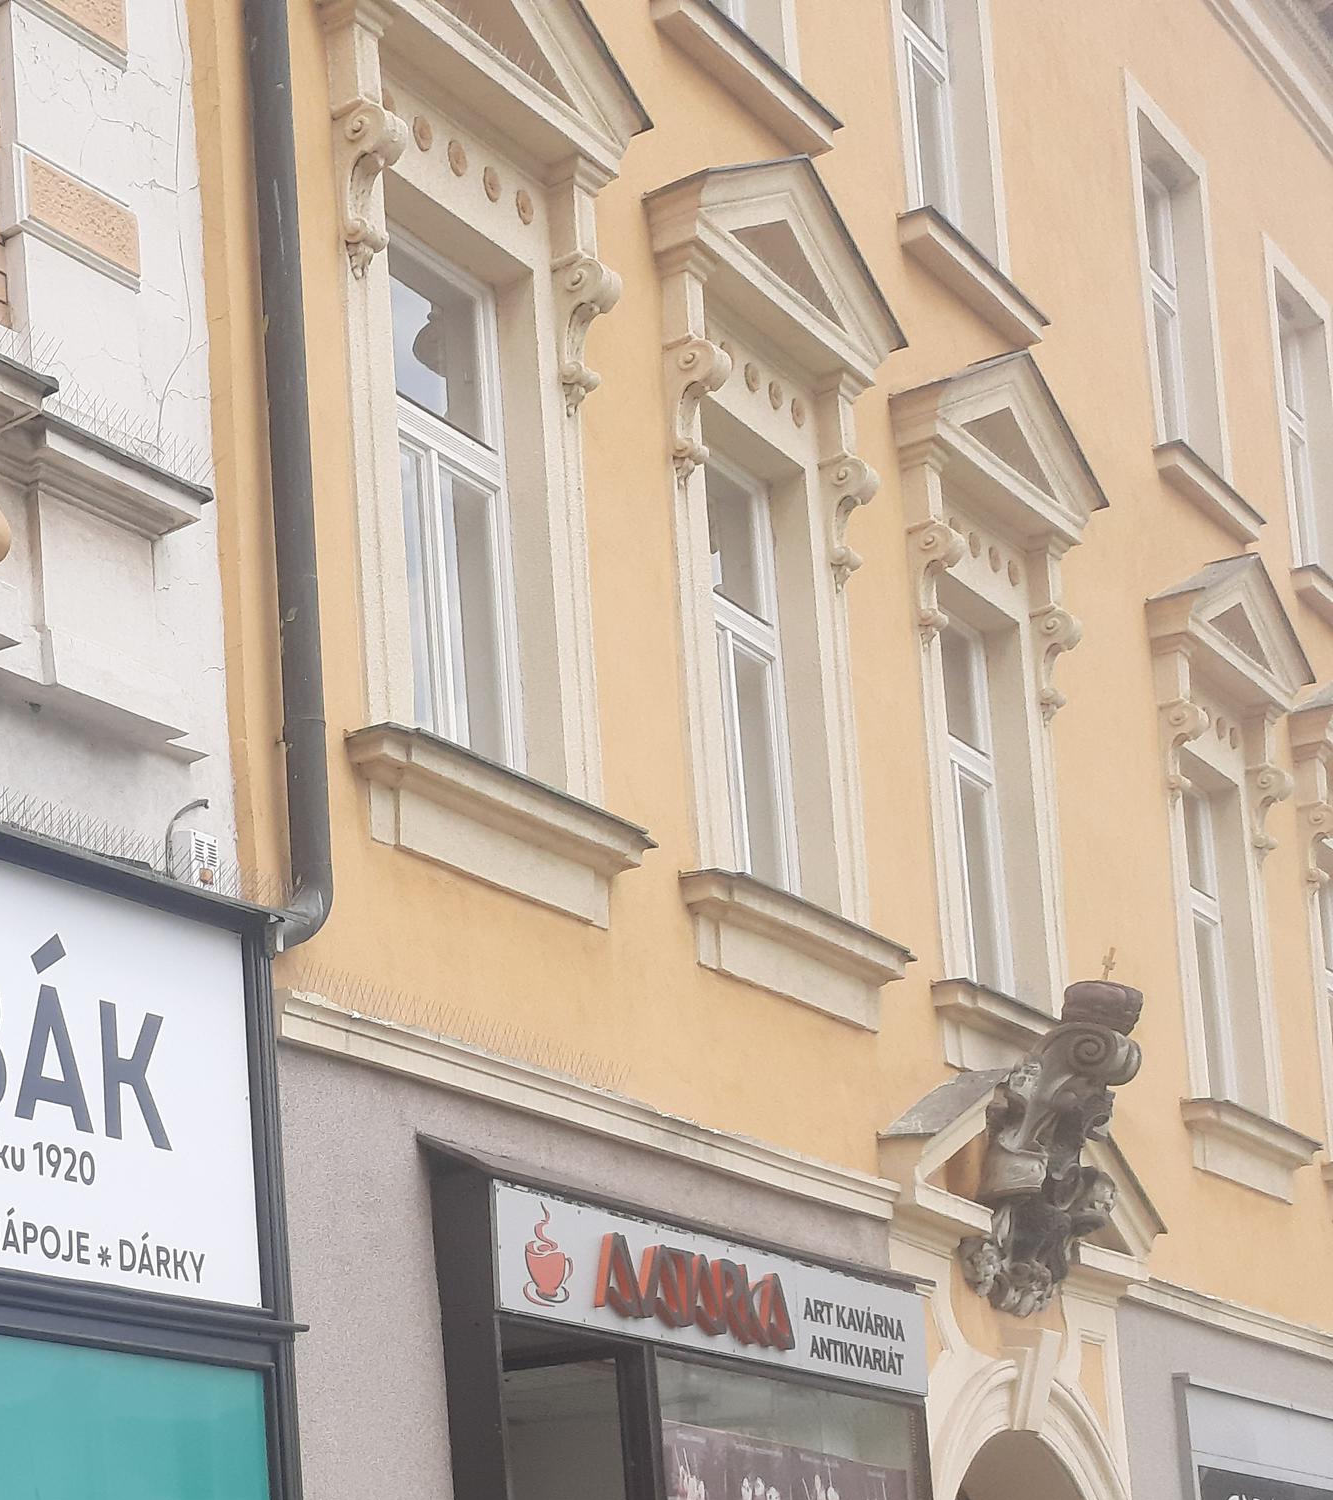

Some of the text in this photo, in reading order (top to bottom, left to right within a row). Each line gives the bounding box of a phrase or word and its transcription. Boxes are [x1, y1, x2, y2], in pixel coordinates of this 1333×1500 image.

[33, 1141, 96, 1186] 1920
[119, 1232, 205, 1285] DÁRKY
[803, 1298, 906, 1342] ART KAVÁRNA
[809, 1336, 904, 1376] ANTIKVARIÁT
